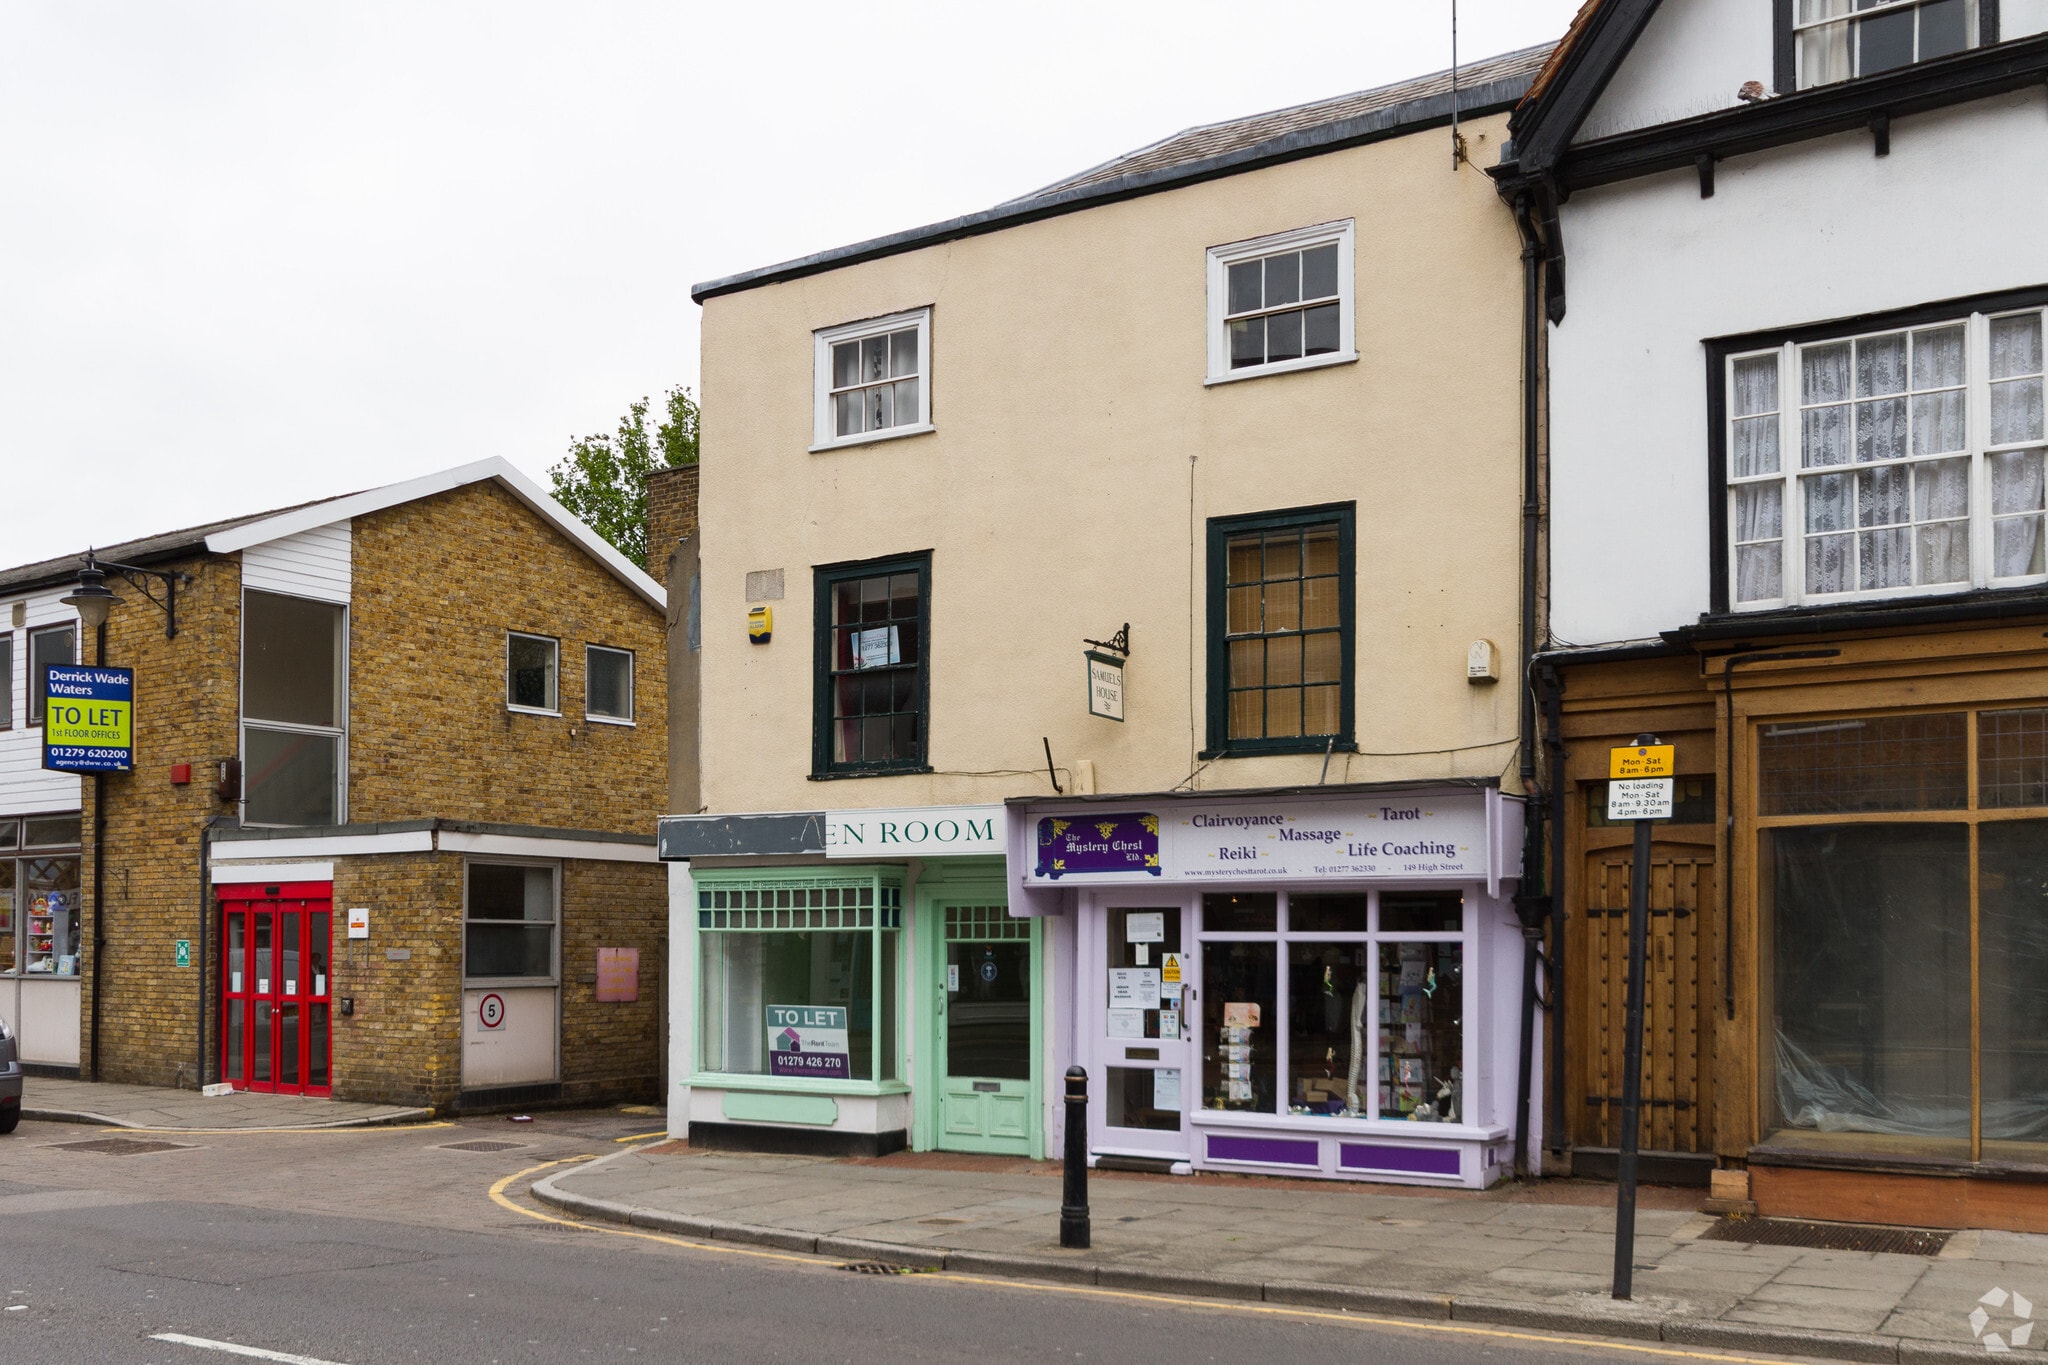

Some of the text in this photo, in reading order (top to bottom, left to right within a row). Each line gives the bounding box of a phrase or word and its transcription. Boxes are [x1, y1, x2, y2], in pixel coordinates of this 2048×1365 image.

[49, 670, 129, 685] Derrick Wade
[1092, 668, 1122, 686] SAMUELS
[50, 683, 93, 695] Waters
[1096, 686, 1118, 702] HOUSE
[52, 706, 122, 726] TO LET
[64, 729, 89, 738] FLOOR
[91, 730, 120, 739] OFFICES
[51, 748, 128, 758] 01279 620200
[1380, 807, 1420, 820] Tarot
[1192, 814, 1284, 830] Clairvoyance
[879, 818, 996, 844] ROOM
[1065, 833, 1081, 842] The
[1278, 828, 1341, 844] Massage
[1066, 839, 1142, 854] Mystery Chest
[1219, 846, 1257, 860] Reiki
[1348, 841, 1456, 858] Life Coaching
[1184, 867, 1288, 877] www.mysterychesttarot.co.uk
[1418, 863, 1438, 873] High
[488, 1004, 495, 1018] 5
[774, 1010, 837, 1026] TO LET
[778, 1056, 841, 1068] 01279 426 270
